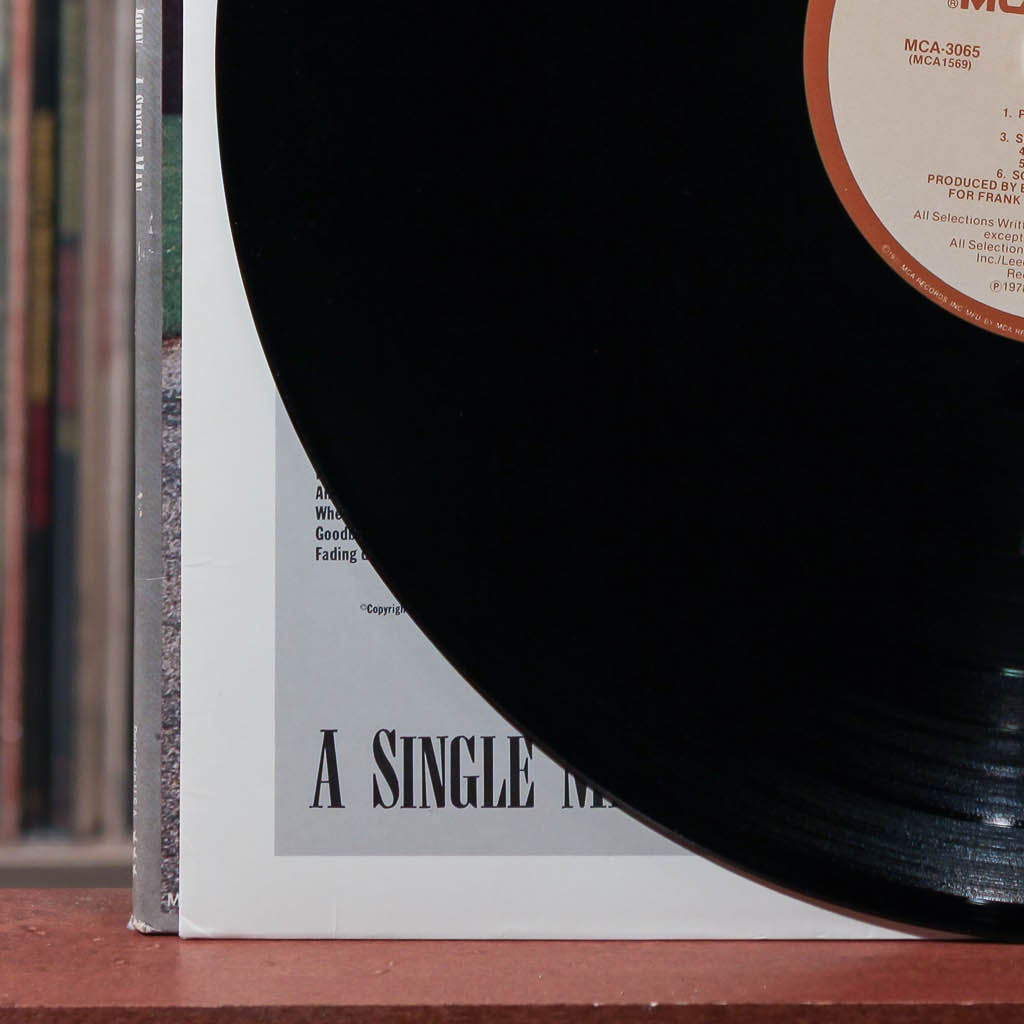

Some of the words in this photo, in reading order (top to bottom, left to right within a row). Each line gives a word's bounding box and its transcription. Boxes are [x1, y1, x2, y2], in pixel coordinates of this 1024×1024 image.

[905, 38, 980, 58] MCA-3065
[909, 54, 971, 71] (MCA1569)
[1003, 107, 1012, 118] 1.
[1000, 132, 1009, 142] 3.
[997, 169, 1006, 178] 6.
[928, 174, 997, 190] PRODUCED
[1001, 182, 1017, 192] BY
[949, 189, 974, 200] FOR
[978, 192, 1020, 205] FRANK
[913, 210, 929, 220] All
[932, 211, 994, 227] Selections
[949, 238, 965, 248] All
[984, 231, 1023, 245] except
[315, 547, 357, 563] Fading
[309, 729, 345, 809] A
[372, 728, 535, 809] SINGLE
